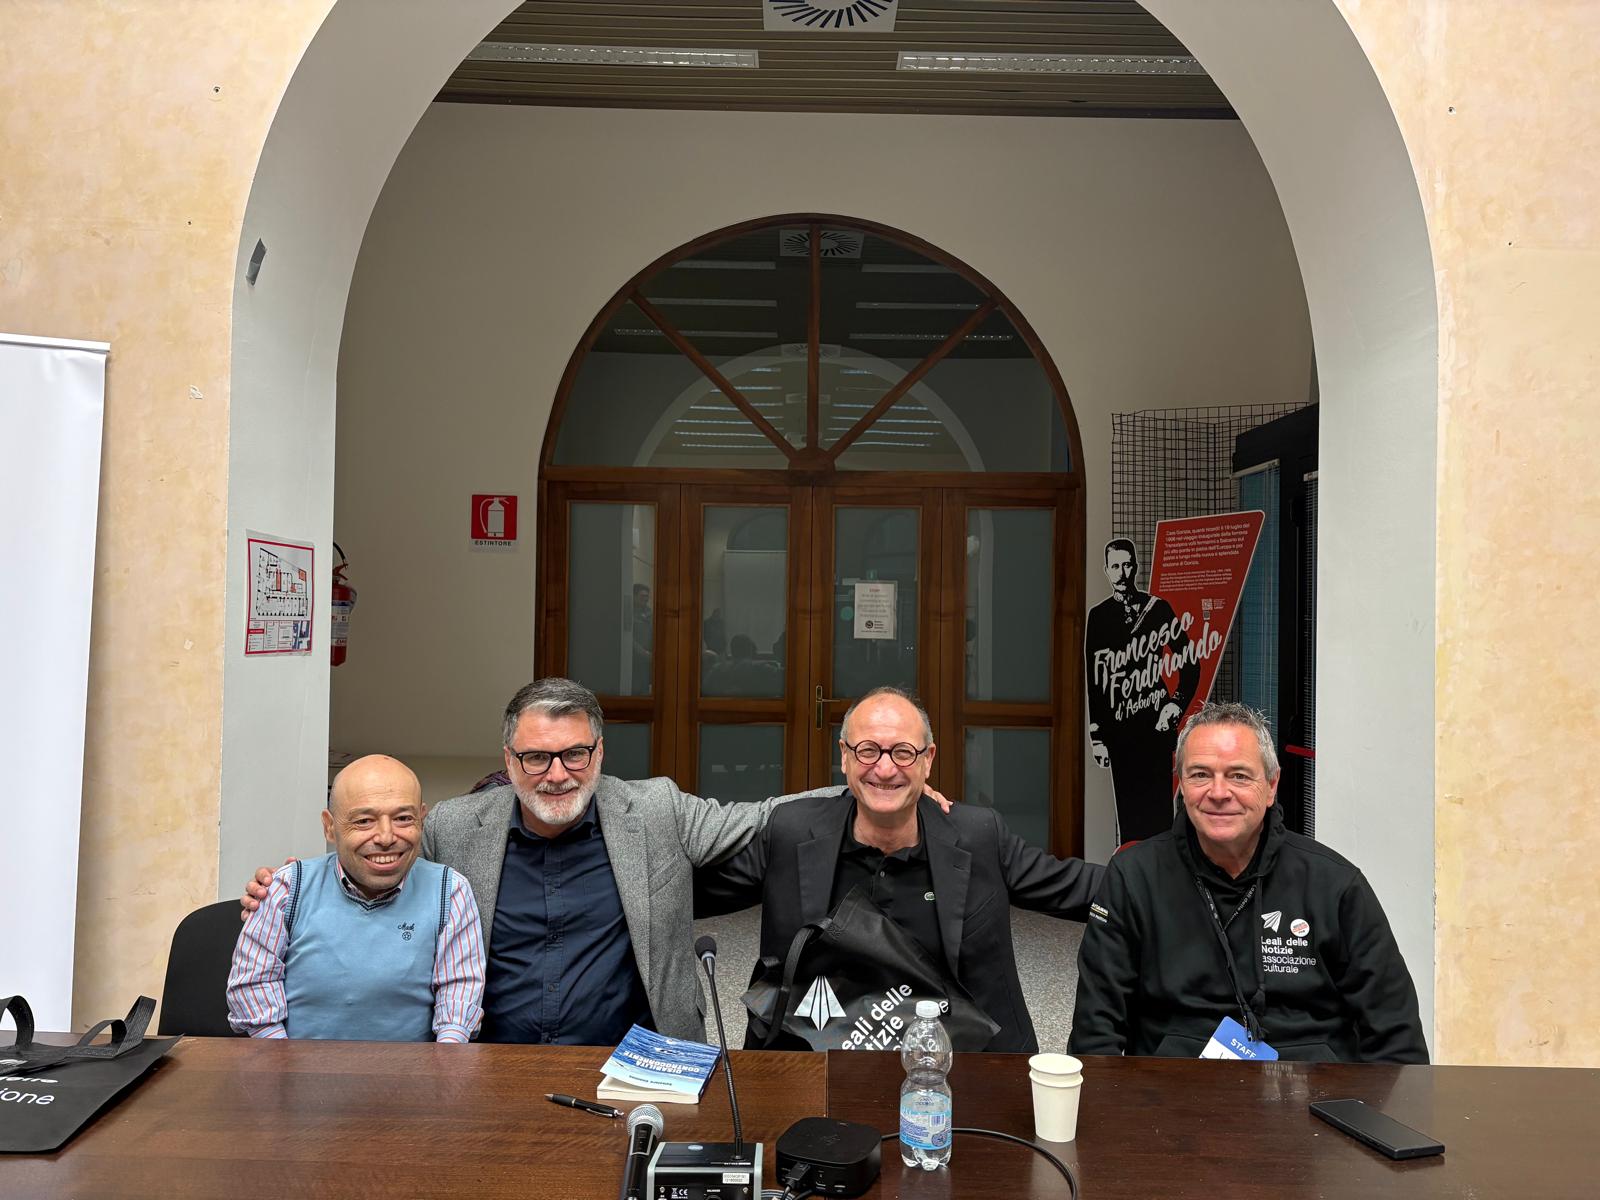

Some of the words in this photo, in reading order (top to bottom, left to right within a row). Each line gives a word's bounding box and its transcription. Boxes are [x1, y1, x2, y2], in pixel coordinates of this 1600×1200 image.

[1094, 611, 1194, 694] Francesco
[1110, 622, 1222, 709] Ferdinando
[1115, 688, 1167, 720] d'Asburgo
[1261, 936, 1282, 946] Leali
[1286, 938, 1308, 946] delle
[1262, 946, 1294, 954] Notizie
[1262, 956, 1316, 965] associazione
[842, 1016, 874, 1050] eali
[870, 984, 912, 1020] delle
[864, 1016, 904, 1050] tizie
[1230, 1038, 1256, 1058] STAFF
[624, 1051, 700, 1073] CONTROCORRENTE
